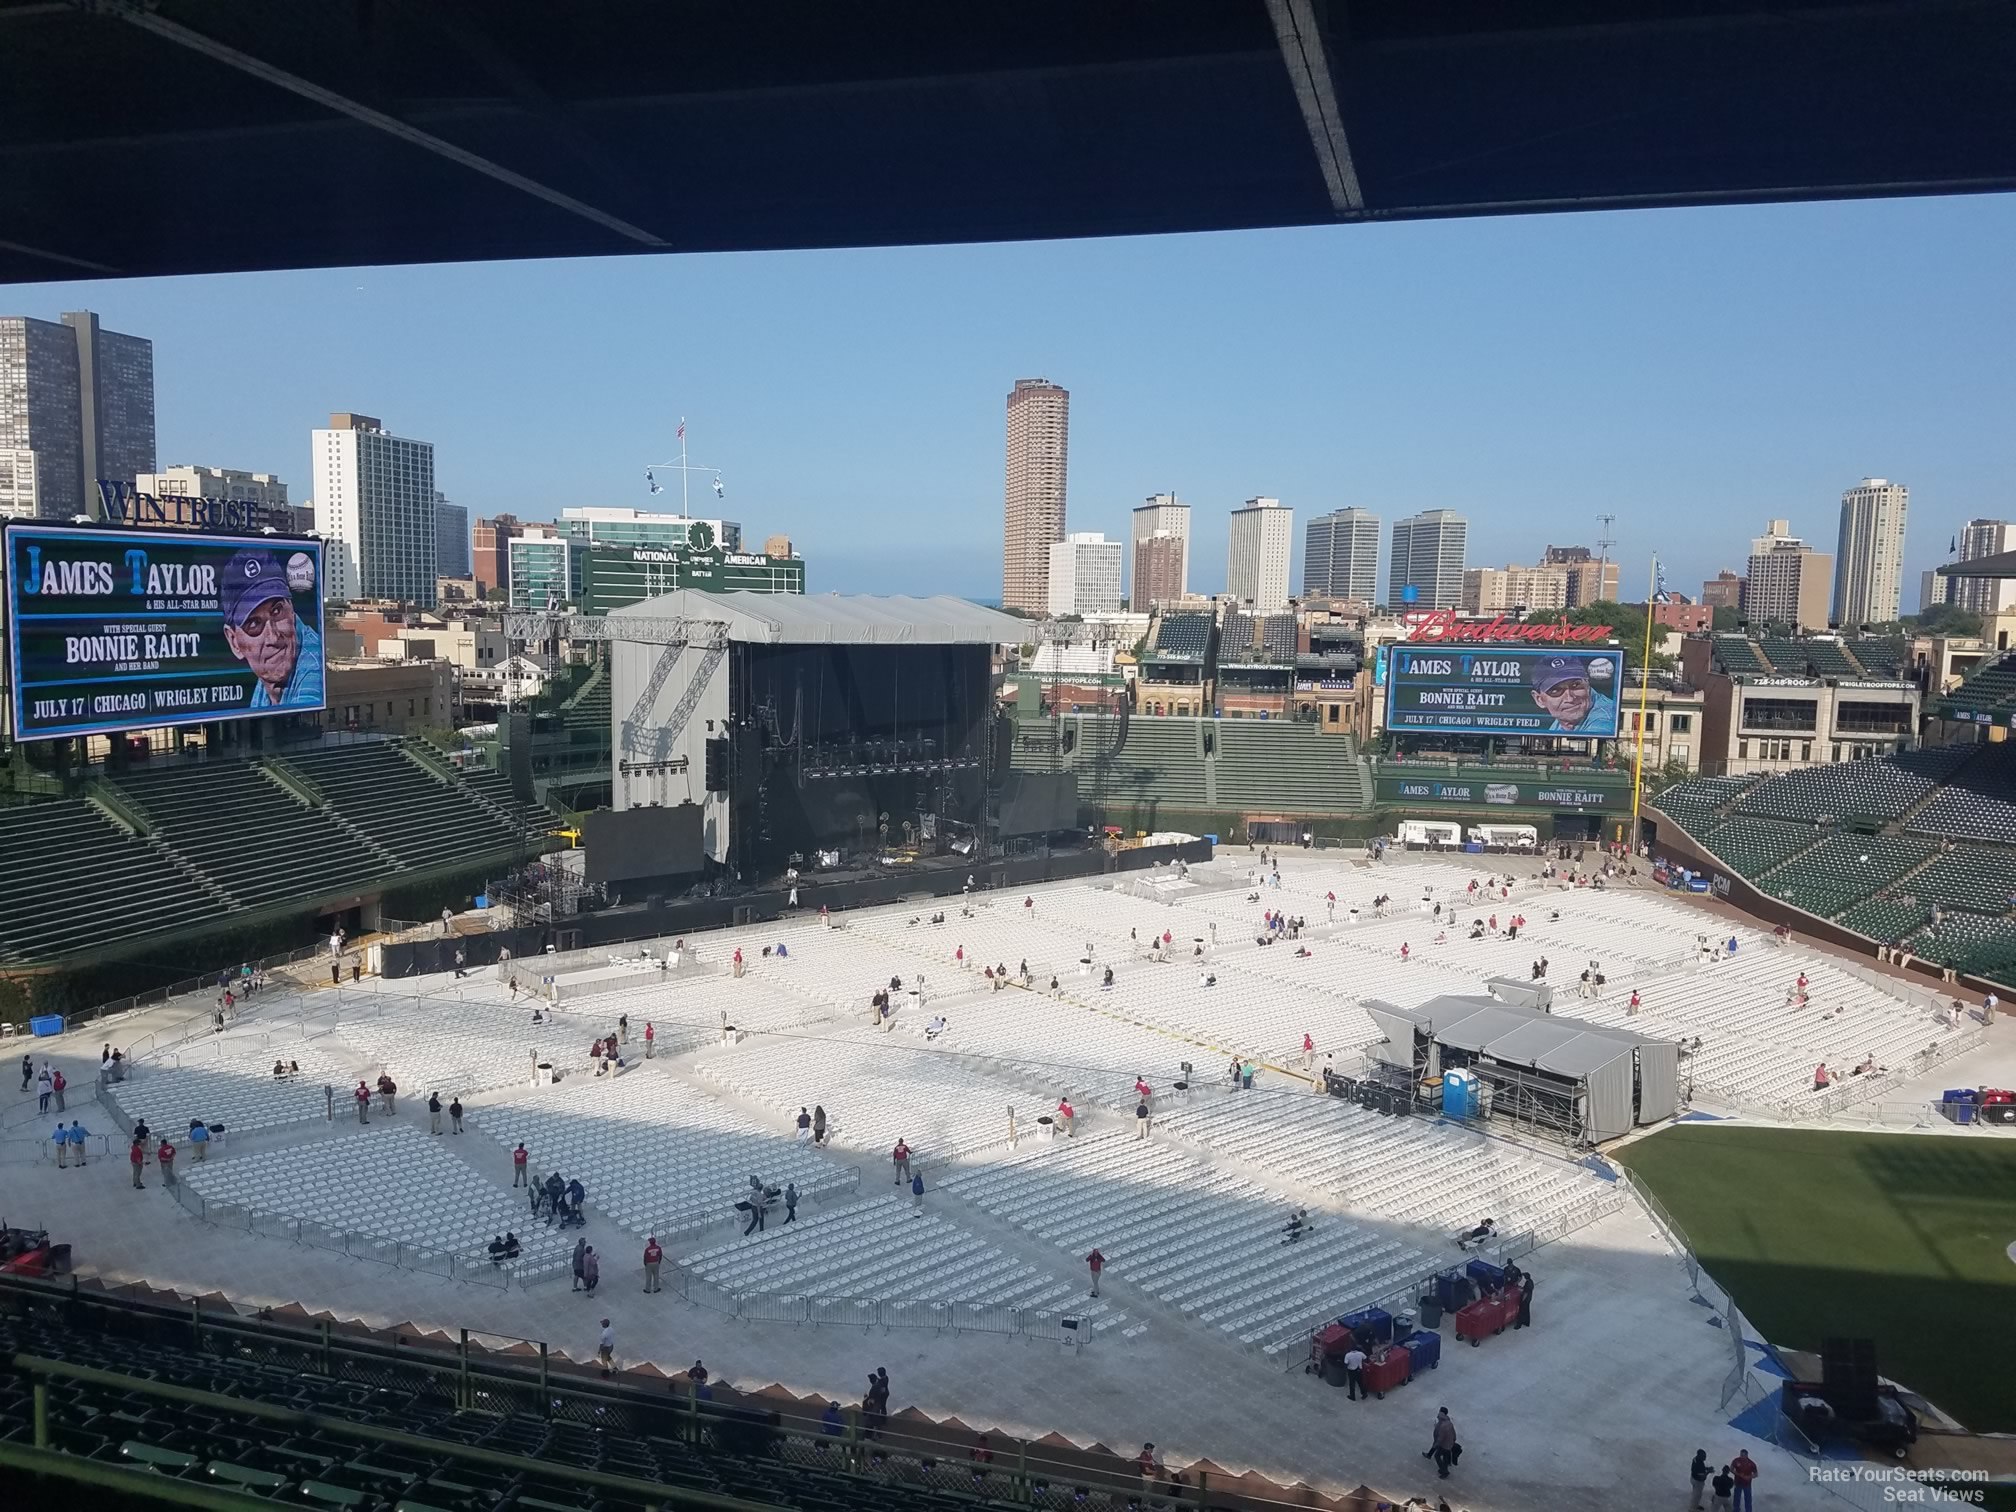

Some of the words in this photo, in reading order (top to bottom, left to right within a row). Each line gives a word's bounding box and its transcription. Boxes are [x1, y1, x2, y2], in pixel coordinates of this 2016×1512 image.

[95, 480, 259, 531] WINTRUST
[633, 551, 679, 562] NATIONAL
[724, 555, 767, 566] AMERICAN
[24, 546, 114, 594] JAMES
[125, 549, 218, 595] TAYLOR
[146, 600, 152, 609] &
[153, 600, 165, 609] HIS
[166, 600, 200, 609] ALL-STAR
[201, 600, 218, 608] BAND
[103, 625, 121, 634] WITH
[121, 624, 147, 633] SPECIAL
[147, 624, 167, 633] GUEST
[1404, 609, 1614, 642] Budweiser
[65, 635, 138, 663] BONNIE
[144, 633, 200, 660] RAITT
[114, 663, 128, 671] AND
[128, 662, 142, 671] HER
[142, 661, 159, 670] BAND
[1400, 654, 1452, 675] JAMES
[1460, 655, 1521, 677] TAYLOR
[1839, 681, 1916, 689] WRIGLEYROOFTOPS.COM
[34, 700, 67, 719] JULY
[72, 697, 84, 716] 17
[94, 693, 146, 713] CHICAGO
[154, 687, 208, 708] WRIGLEY
[211, 685, 243, 702] FIELD
[1420, 692, 1463, 705] BONNIE
[1467, 693, 1505, 706] RAITT
[1404, 715, 1424, 724] JULY
[1425, 715, 1434, 724] 17
[1439, 716, 1472, 725] CHICAGO
[1476, 717, 1514, 726] WRIGLEY
[1516, 718, 1540, 727] FIELD
[1953, 708, 1970, 720] JAMES
[1972, 710, 1992, 721] TAYLOR
[1398, 781, 1429, 795] JAMES
[1433, 783, 1471, 797] TAYLOR
[1538, 791, 1572, 802] BONNIE
[1575, 792, 1604, 803] RAITT
